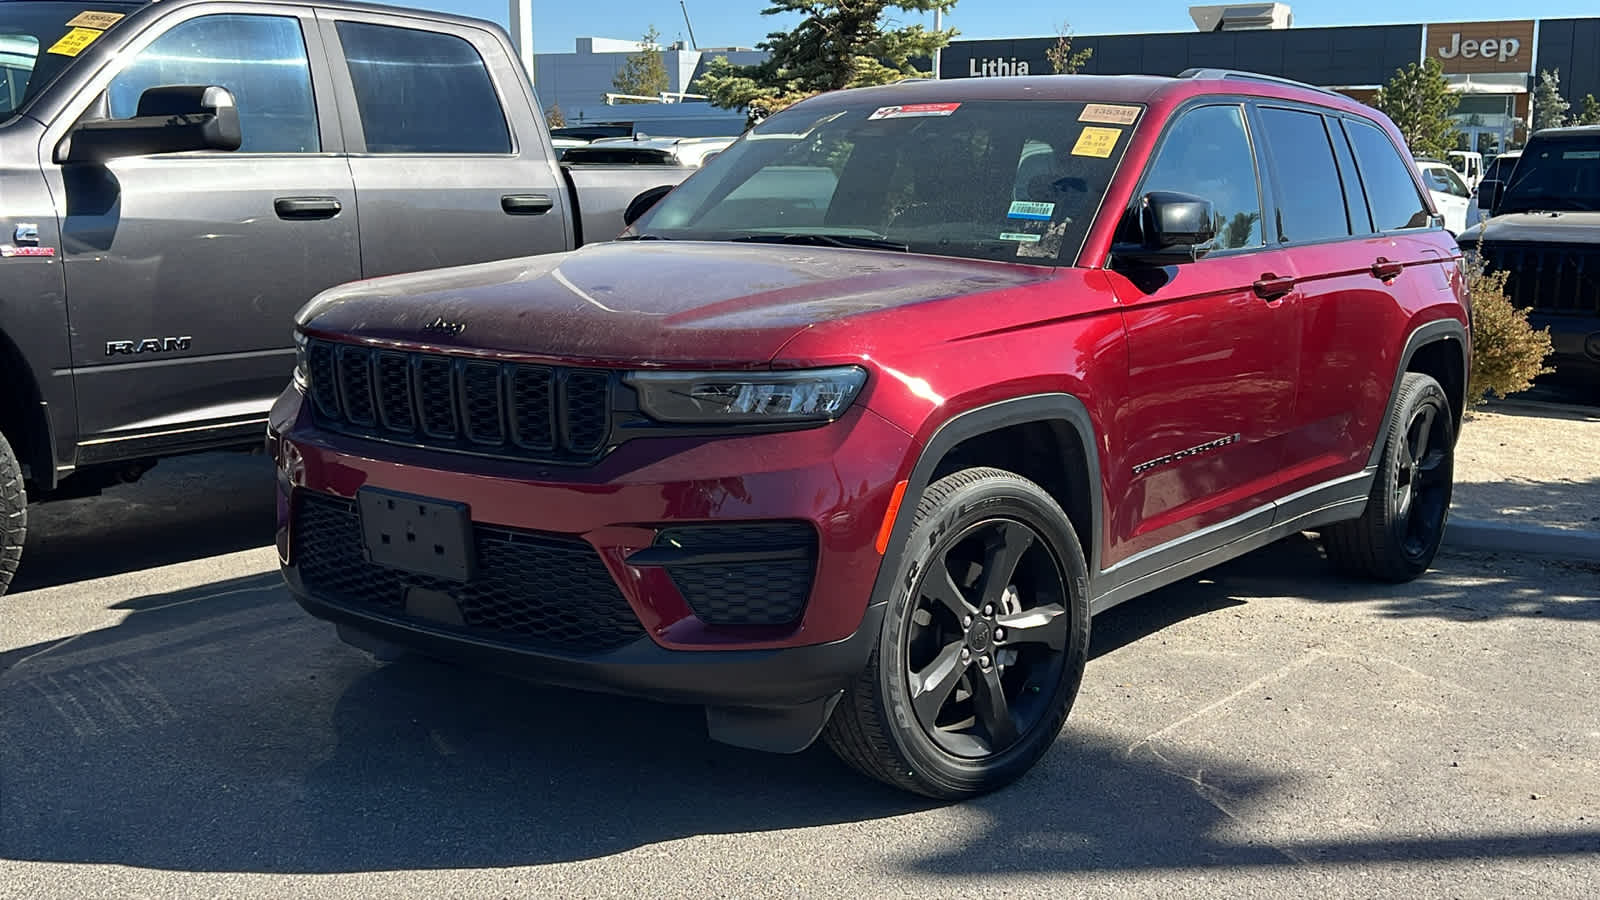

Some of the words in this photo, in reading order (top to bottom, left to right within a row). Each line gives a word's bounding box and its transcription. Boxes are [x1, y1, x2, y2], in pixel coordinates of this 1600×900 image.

[1438, 32, 1520, 62] Jeep
[970, 57, 1029, 77] Lithia
[105, 336, 192, 356] RAM
